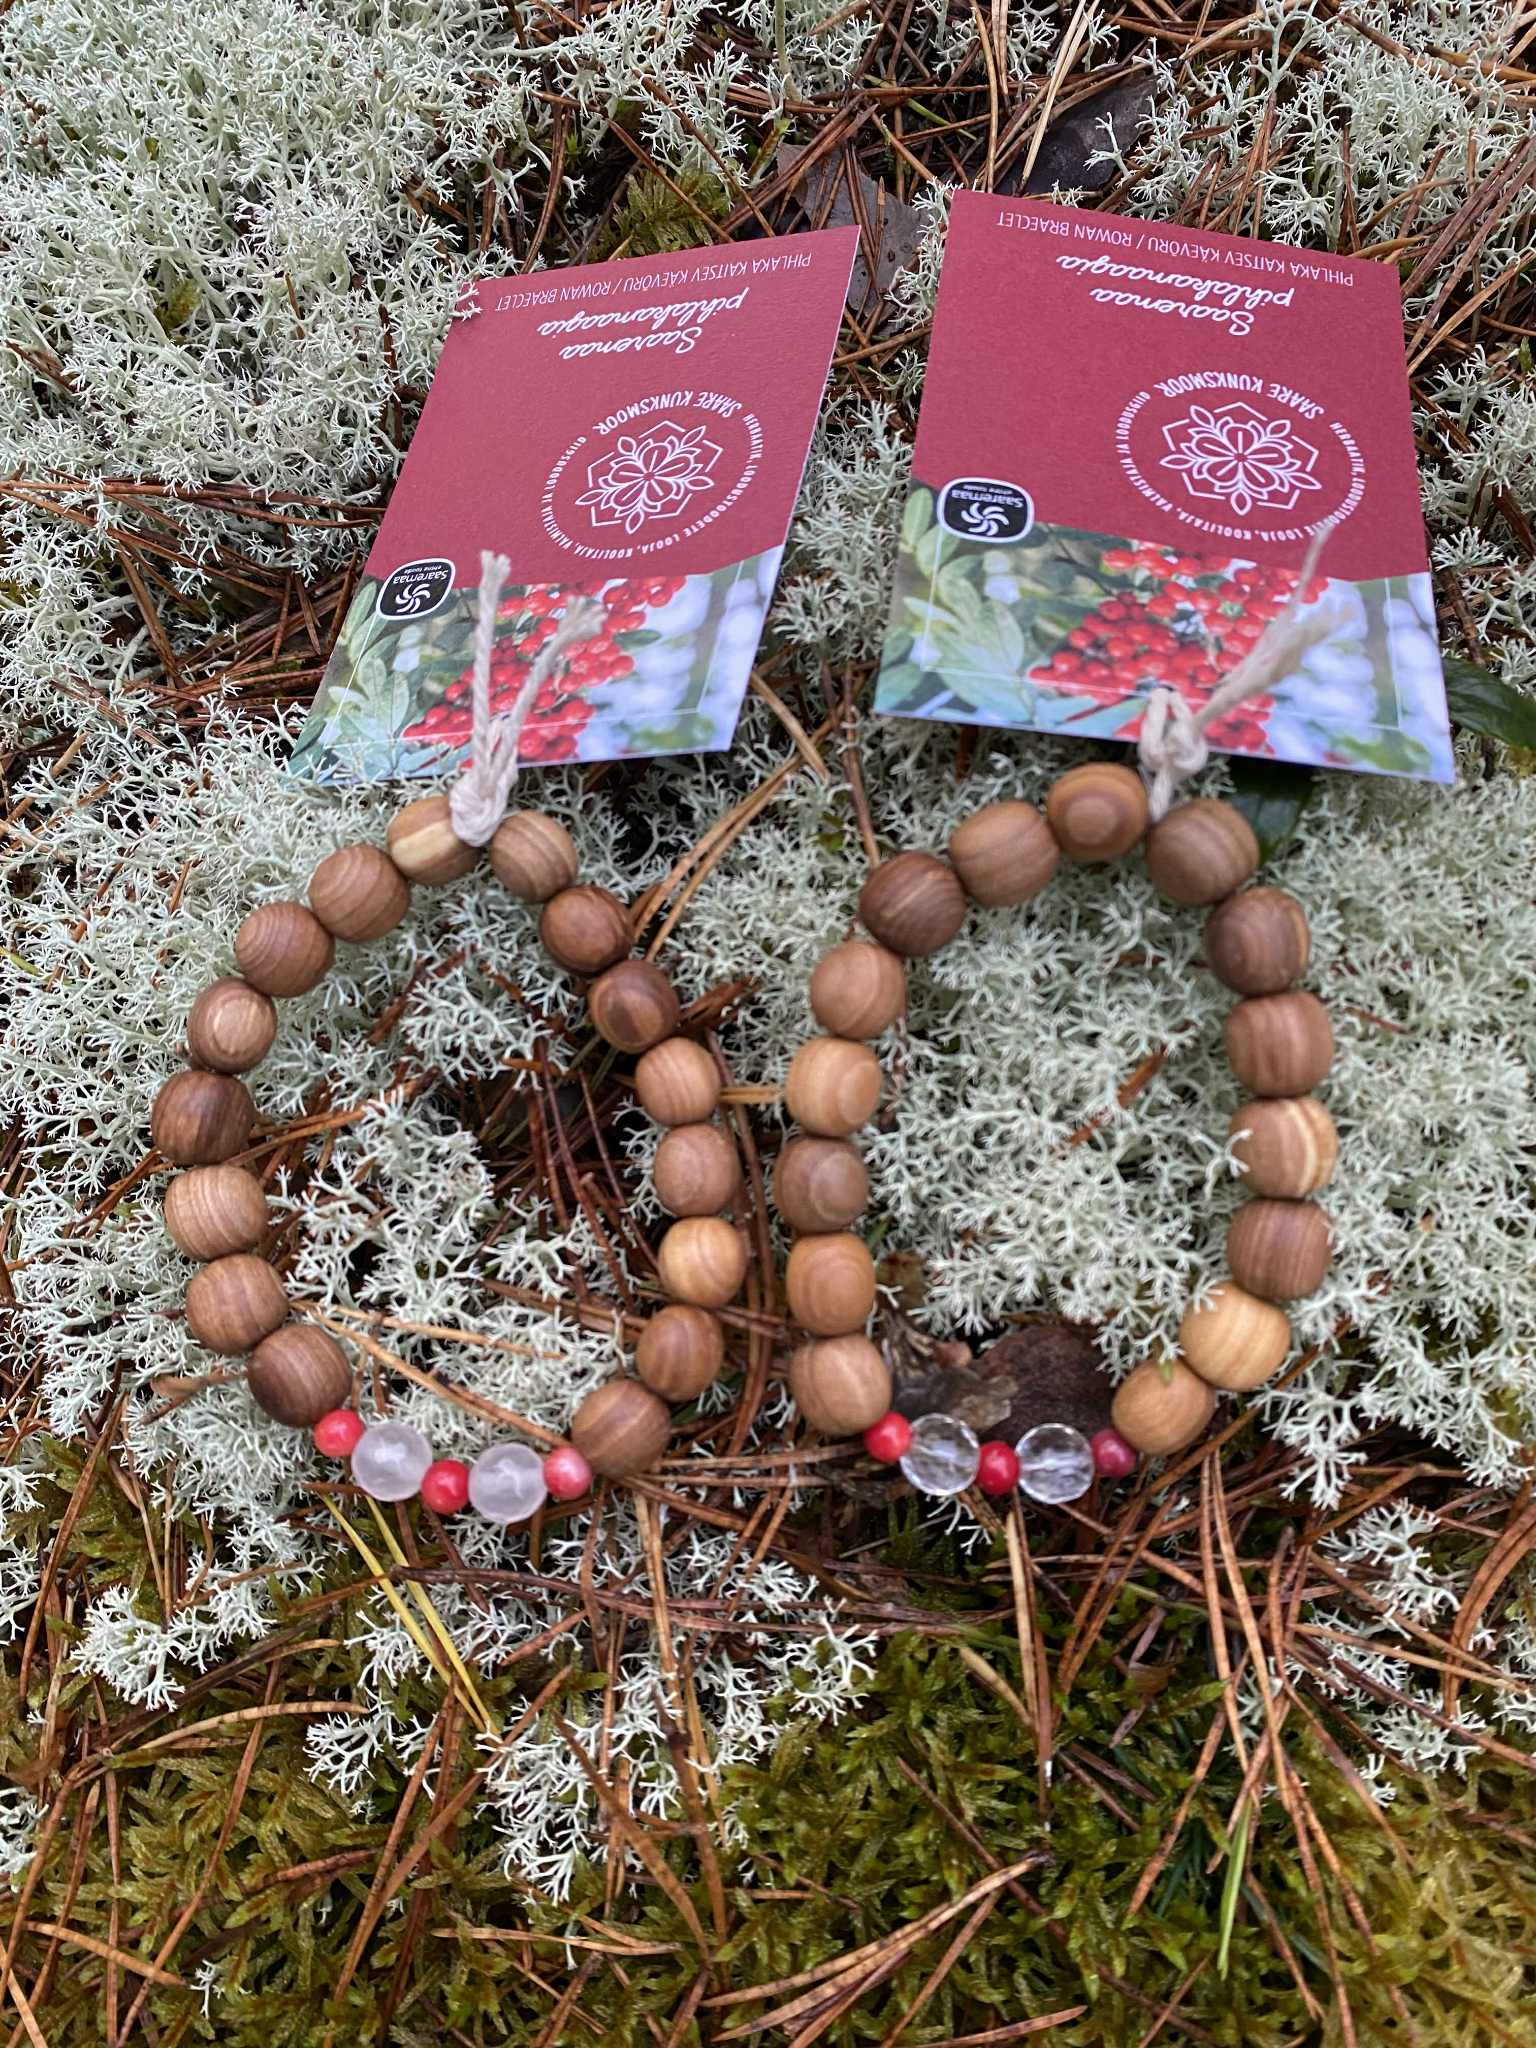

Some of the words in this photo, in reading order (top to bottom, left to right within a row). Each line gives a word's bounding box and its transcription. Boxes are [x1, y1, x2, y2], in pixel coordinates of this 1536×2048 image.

[996, 210, 1070, 236] BRAECLET
[1073, 223, 1133, 247] ROWAN
[1136, 233, 1146, 250] /
[1147, 236, 1221, 264] KÄEVÕRU
[690, 260, 748, 281] KAITSEV
[751, 252, 812, 274] PIHLAKA
[1223, 252, 1286, 274] KAITSEV
[1289, 262, 1354, 287] PIHLAKA
[559, 281, 611, 301] ROWAN
[612, 279, 622, 295] /
[622, 268, 689, 292] KÄEVÕRU
[1055, 254, 1296, 309] pihlakamaagia
[494, 289, 558, 312] BRAECLET
[1089, 287, 1255, 336] Saaremaa
[535, 287, 750, 339] pihlakamaagia
[558, 325, 703, 361] Saaremaa
[1153, 370, 1264, 398] KUNKSMOOR
[592, 390, 694, 436] KUNKSMOOR
[693, 391, 743, 418] SAARE
[1266, 382, 1325, 420] SAARE
[951, 489, 1024, 508] Saaremaa
[393, 569, 449, 584] Saaremaa
